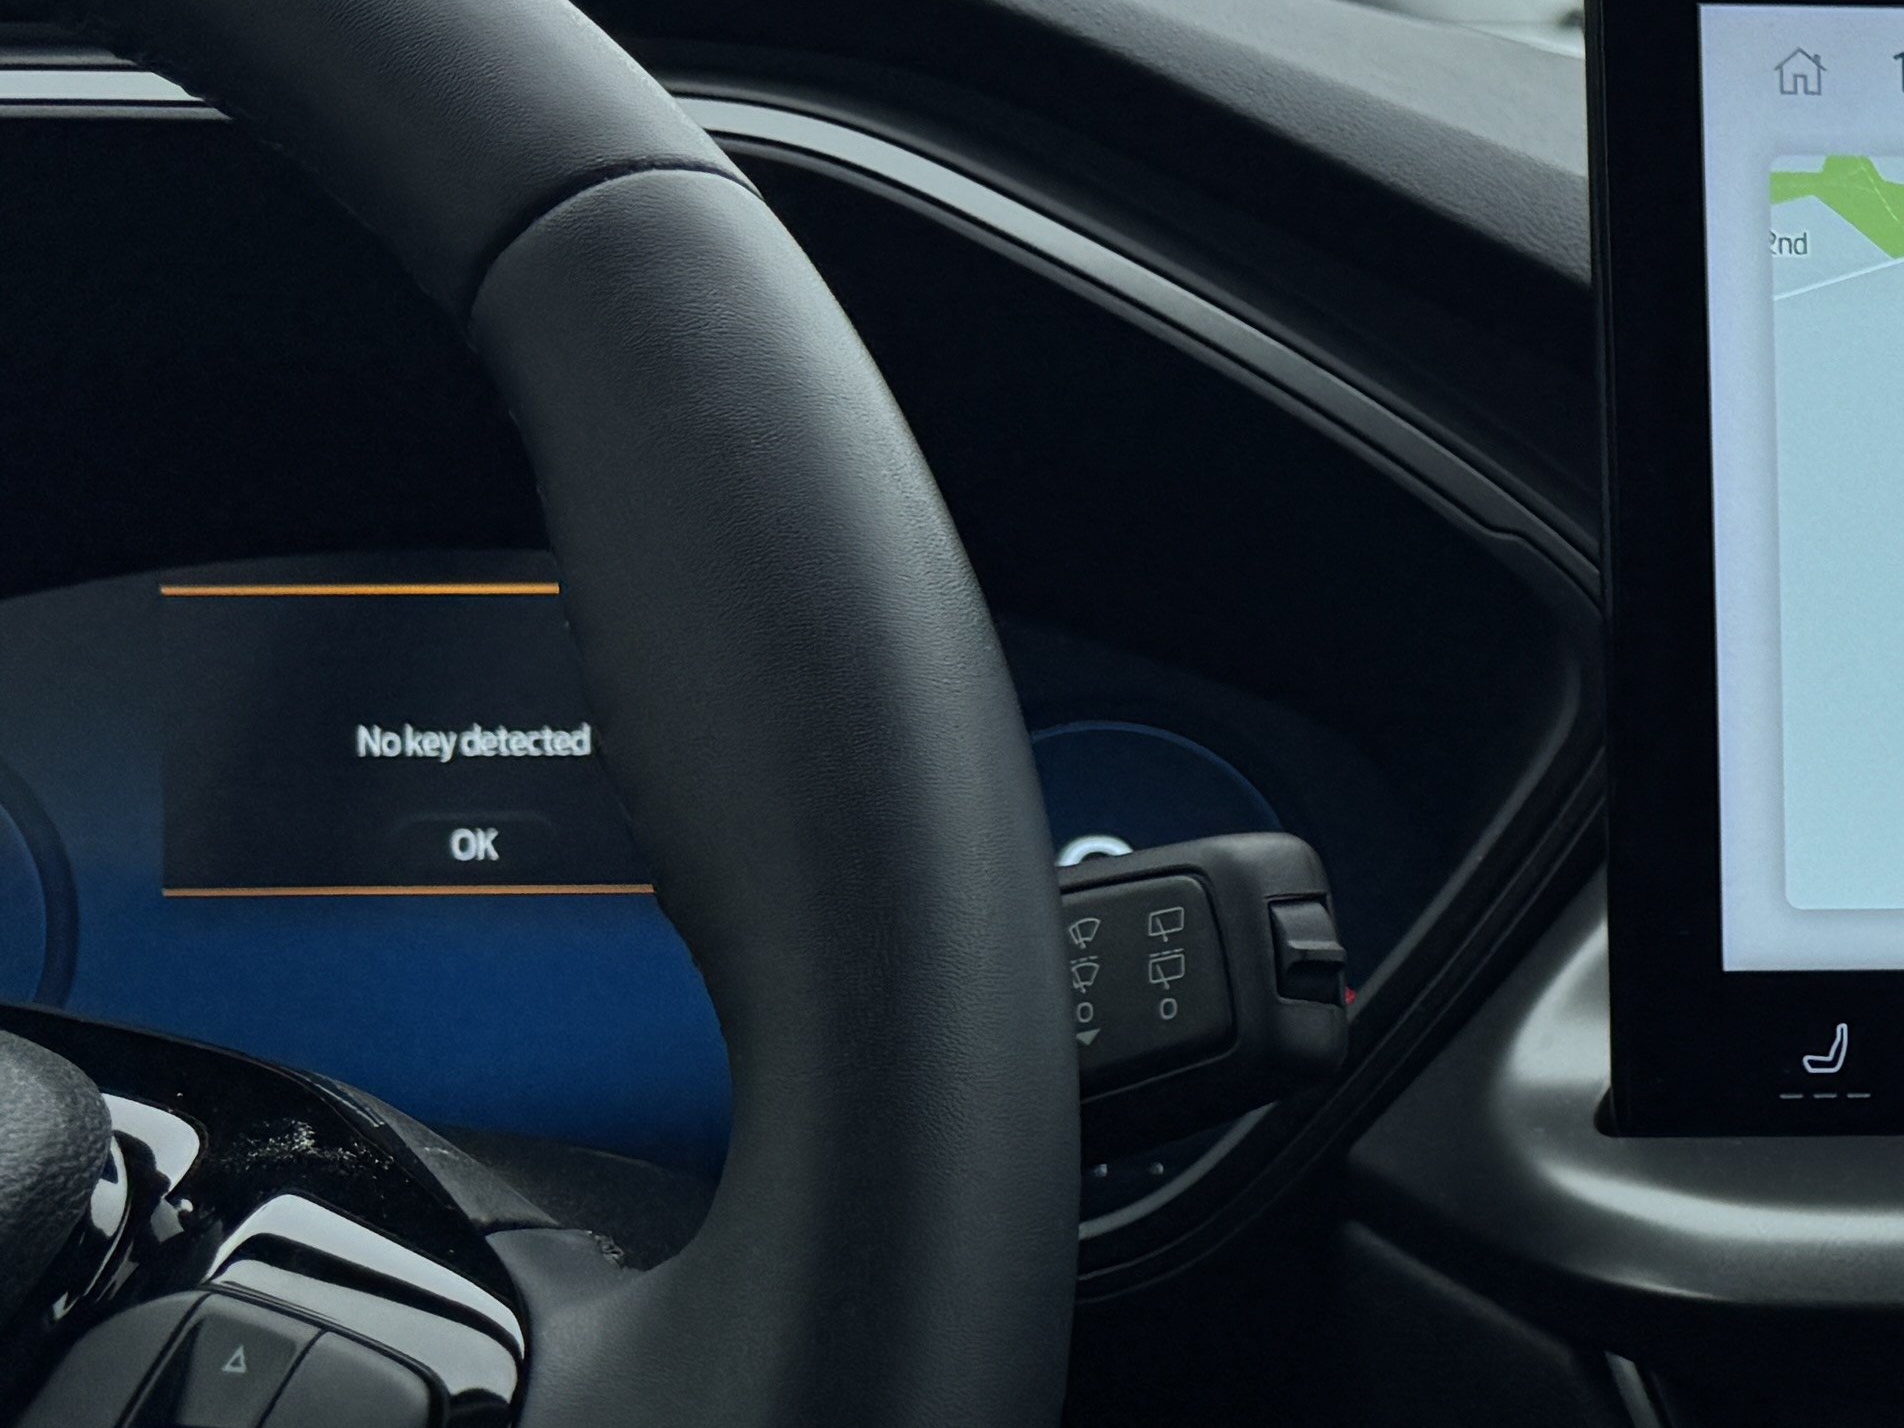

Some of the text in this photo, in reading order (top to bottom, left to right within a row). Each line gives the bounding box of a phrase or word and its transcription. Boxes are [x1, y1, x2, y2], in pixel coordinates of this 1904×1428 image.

[357, 723, 591, 762] No key detected
[451, 828, 499, 860] OK
